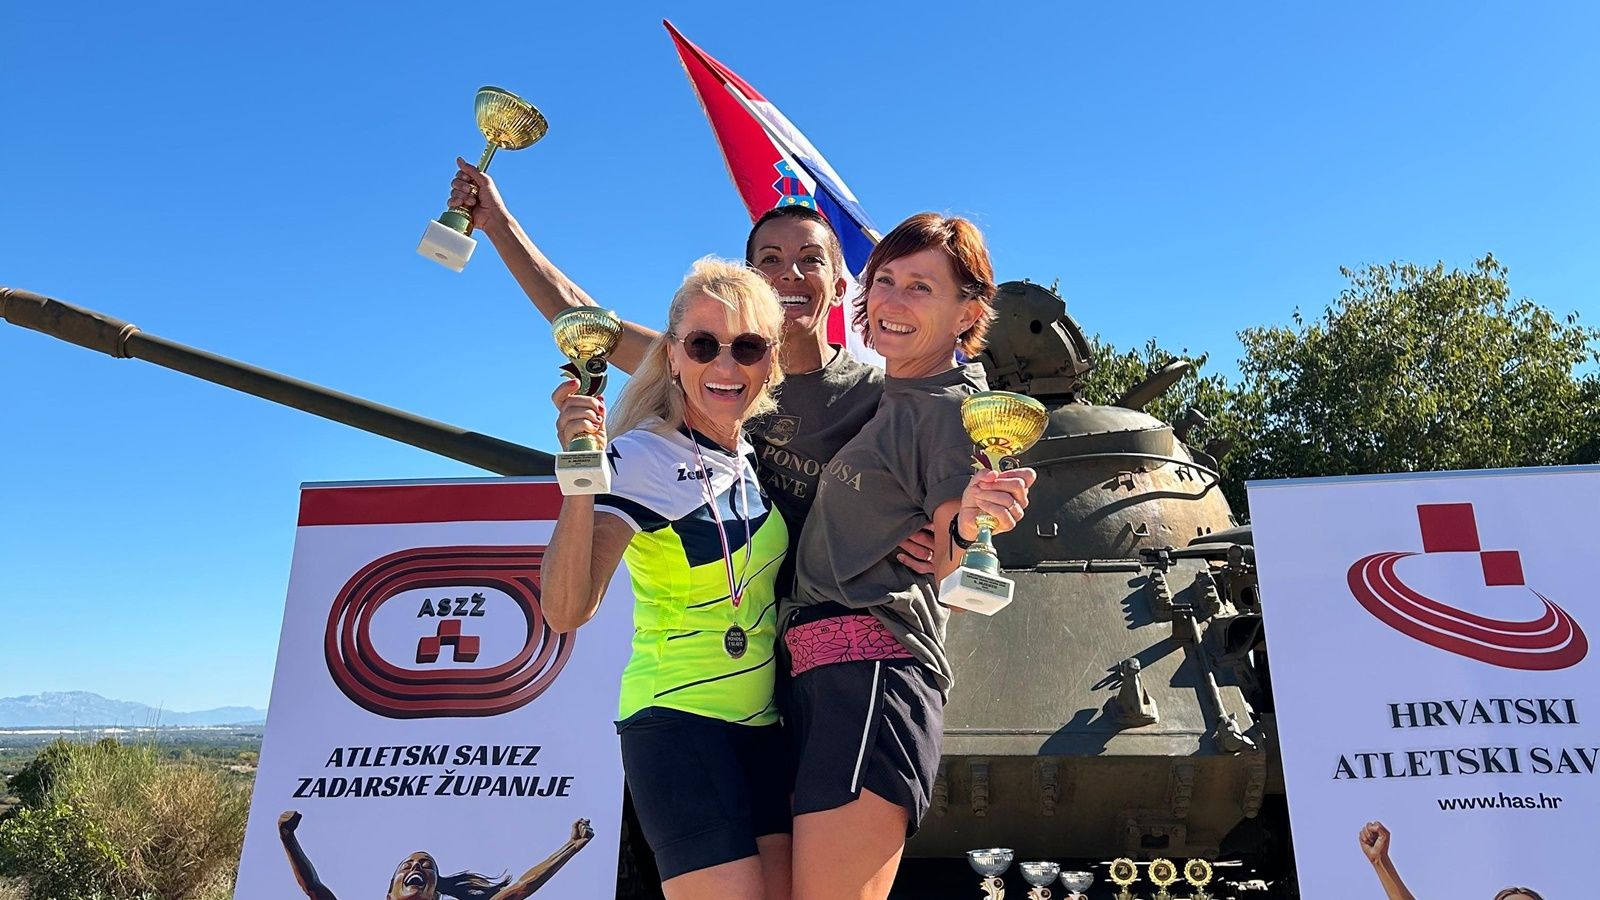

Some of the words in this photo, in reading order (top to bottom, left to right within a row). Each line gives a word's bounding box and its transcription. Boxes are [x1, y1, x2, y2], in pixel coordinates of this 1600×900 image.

[416, 592, 486, 618] ASZŽ
[1386, 697, 1580, 730] HRVATSKI
[325, 744, 450, 768] ATLETSKI
[452, 744, 542, 766] SAVEZ
[1332, 747, 1521, 780] ATLETSKI
[292, 775, 434, 798] ZADARSKE
[434, 768, 575, 797] ŽUPANIJE
[1437, 791, 1563, 811] www.has.hr
